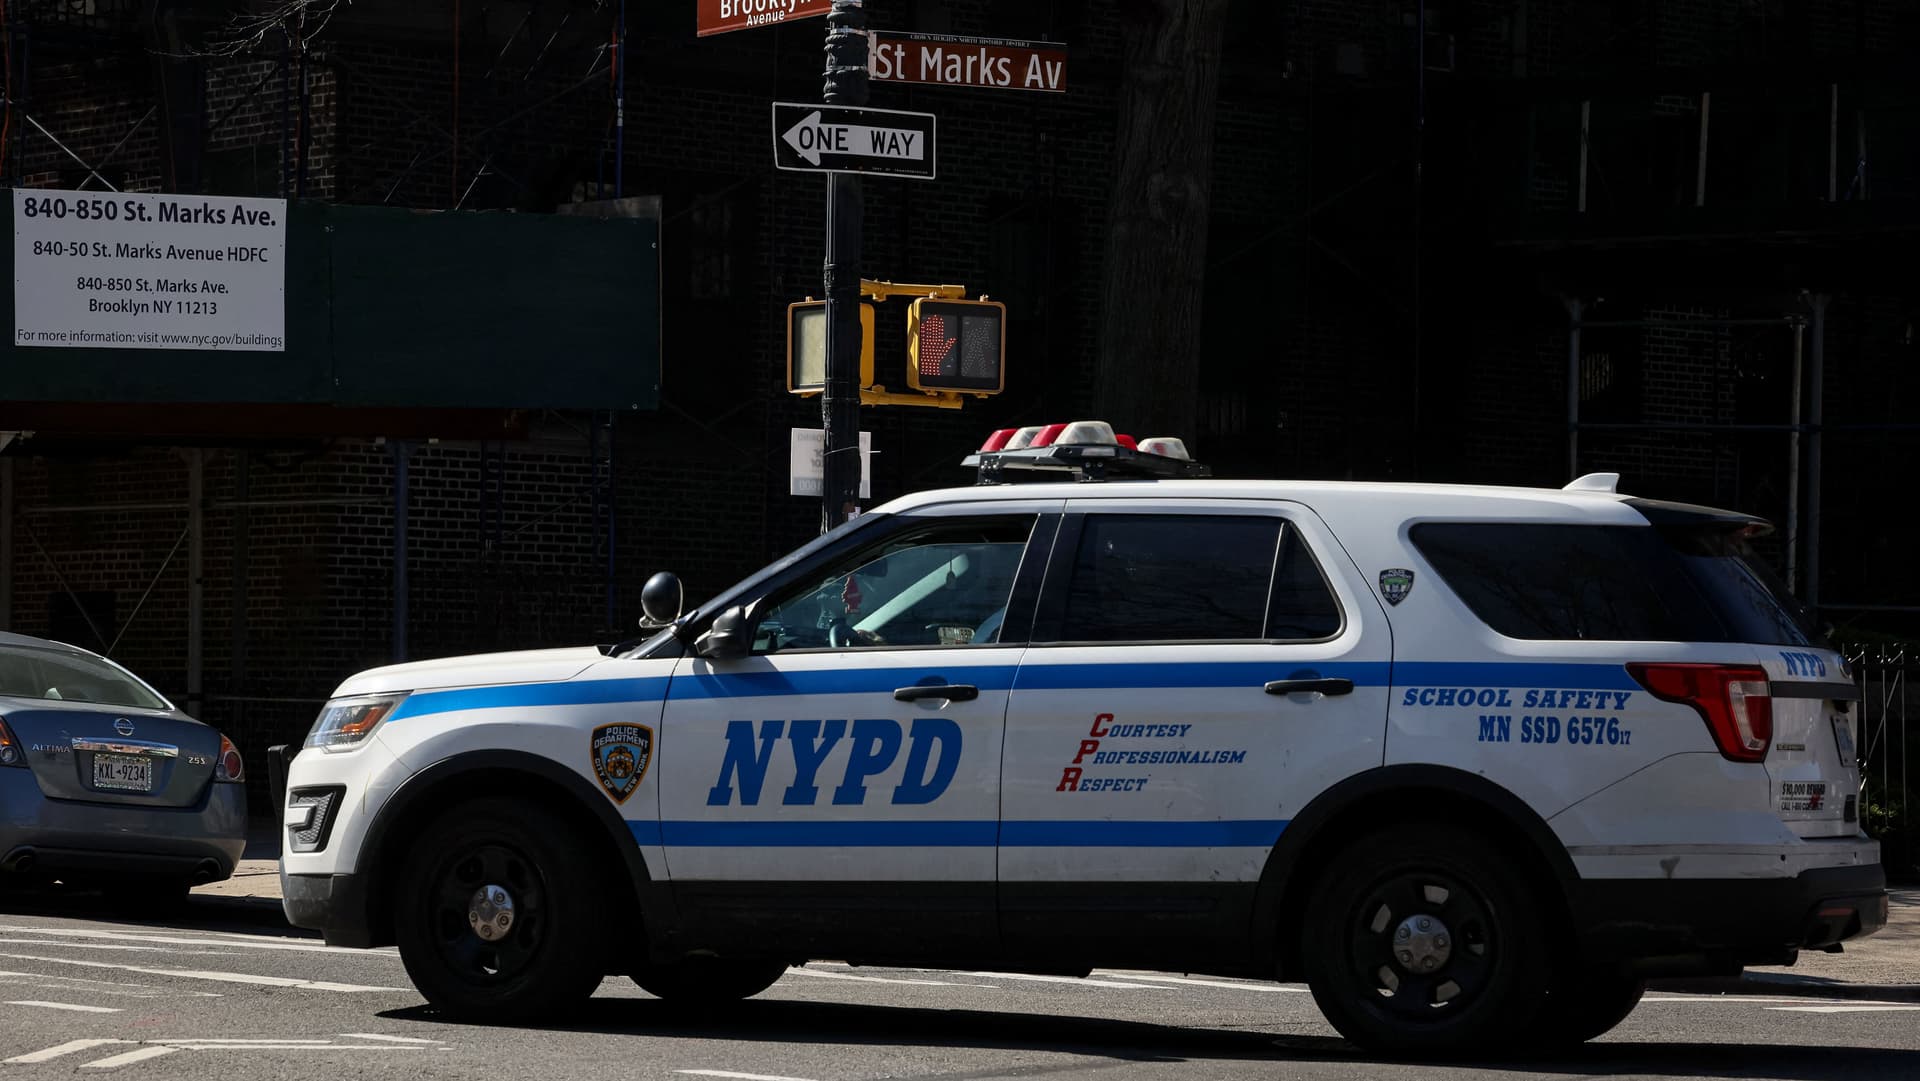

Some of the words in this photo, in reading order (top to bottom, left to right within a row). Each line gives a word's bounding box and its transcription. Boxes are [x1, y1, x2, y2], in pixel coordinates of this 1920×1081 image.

[720, 0, 811, 19] Brooy
[746, 10, 785, 26] Avenue
[876, 43, 905, 79] St
[920, 46, 1012, 87] Marks
[1024, 53, 1062, 90] Av
[799, 126, 849, 151] ONE
[871, 130, 915, 156] WAY
[24, 197, 118, 221] 840-850
[124, 201, 152, 223] St.
[158, 202, 226, 225] Marks
[231, 205, 277, 227] Ave.
[33, 240, 88, 257] 840-50
[93, 242, 112, 258] St.
[116, 243, 162, 260] Marks
[166, 245, 224, 262] Avenue
[228, 247, 269, 263] HDFC
[77, 277, 132, 292] 840-850
[135, 279, 153, 293] St.
[156, 279, 198, 294] Marks
[201, 280, 229, 295] Ave.
[89, 299, 149, 316] Brooklyn
[153, 300, 173, 314] NY
[177, 301, 217, 315] 11213
[17, 329, 35, 341] For
[38, 331, 67, 342] more
[69, 330, 136, 343] information:
[137, 332, 159, 343] visit
[161, 333, 283, 348] www.nyc.gov/buildings
[1780, 651, 1826, 677] NYPD
[1402, 687, 1512, 708] SCHOOL
[1522, 689, 1632, 710] SAFETY
[605, 726, 639, 736] POLICE
[1478, 715, 1512, 742] MN
[1520, 715, 1561, 744] SSD
[32, 743, 71, 753] ALTIMA
[593, 734, 649, 749] DEPARTMENT
[594, 757, 606, 777] CITY
[603, 779, 614, 789] OF
[624, 777, 638, 793] NEW
[636, 752, 649, 774] YORK
[706, 718, 963, 806] NYPD
